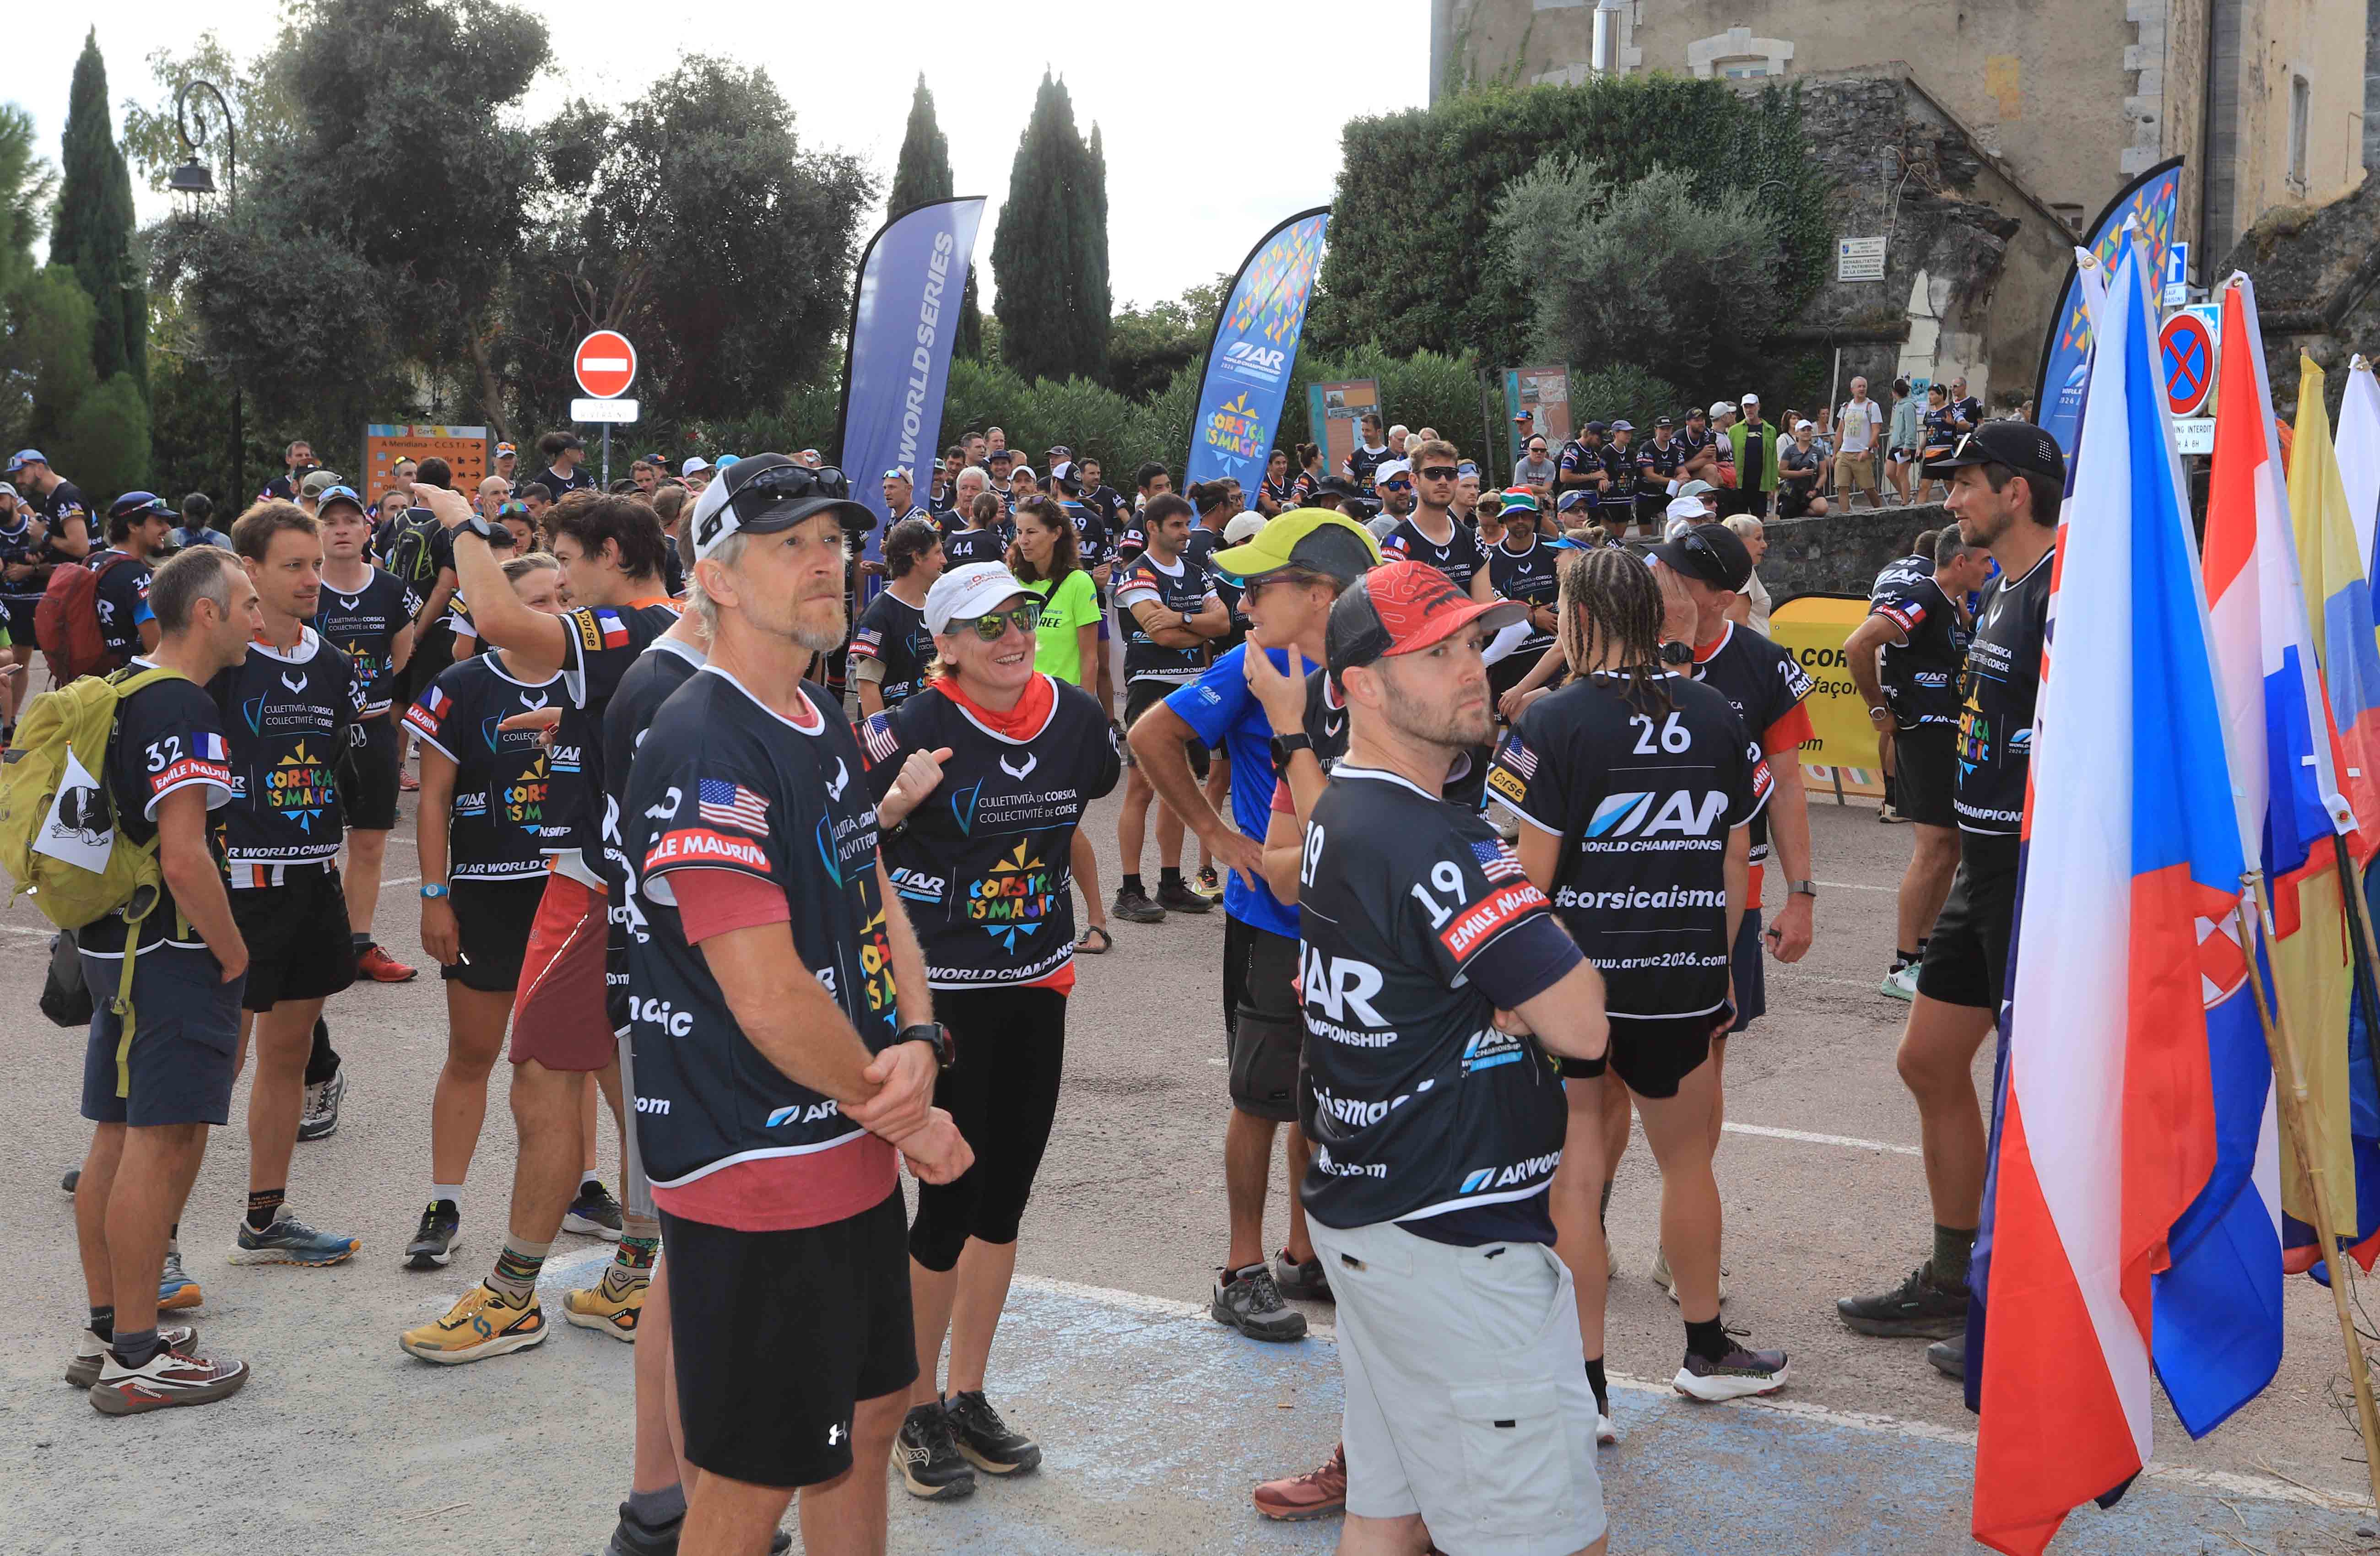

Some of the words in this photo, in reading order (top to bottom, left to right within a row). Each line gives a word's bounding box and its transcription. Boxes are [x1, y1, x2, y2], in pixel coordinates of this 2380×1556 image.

[1223, 356, 1242, 366] WORLD
[1245, 347, 1284, 370] AR
[2188, 425, 2212, 433] INTERDIT
[952, 541, 973, 556] 44
[132, 573, 151, 591] 34
[579, 614, 595, 646] Corse
[1987, 643, 2012, 659] CORSICA
[1986, 657, 2009, 673] CORSE
[894, 681, 909, 691] AR
[1927, 673, 1948, 682] AR
[264, 703, 306, 715] CULLETTIVITÀ
[312, 705, 334, 717] CORSICA
[407, 707, 438, 732] MAURIN
[265, 714, 314, 727] COLLECTIVITÉ
[316, 717, 334, 729] CORSE
[1629, 711, 1692, 755] 26
[146, 735, 184, 773] 32
[155, 763, 188, 790] EMILE
[231, 776, 246, 789] R
[265, 768, 334, 789] CORSICA
[1493, 771, 1523, 797] Corse
[284, 788, 333, 806] MAGIC
[465, 793, 486, 807] AR
[979, 791, 1035, 808] CULLETTIVITÀ
[1044, 789, 1076, 802] CORSICA
[979, 805, 1043, 824] COLLECTIVITÉ
[1045, 809, 1054, 817] DE
[1055, 803, 1077, 816] CORSE
[242, 845, 299, 857] WORLD
[682, 835, 768, 865] MAURIN
[1301, 820, 1325, 889] 19
[467, 863, 485, 875] AR
[487, 860, 542, 873] WORLD
[906, 872, 945, 894] AR
[1411, 860, 1467, 930] 19
[1449, 906, 1499, 953] EMILE
[1305, 946, 1393, 1027] AR
[634, 1095, 670, 1115] om
[1495, 1166, 1526, 1188] AR
[1699, 1363, 1715, 1375] LA
[1718, 1366, 1774, 1381] SPORTIVA
[132, 1383, 163, 1399] SALOMON
